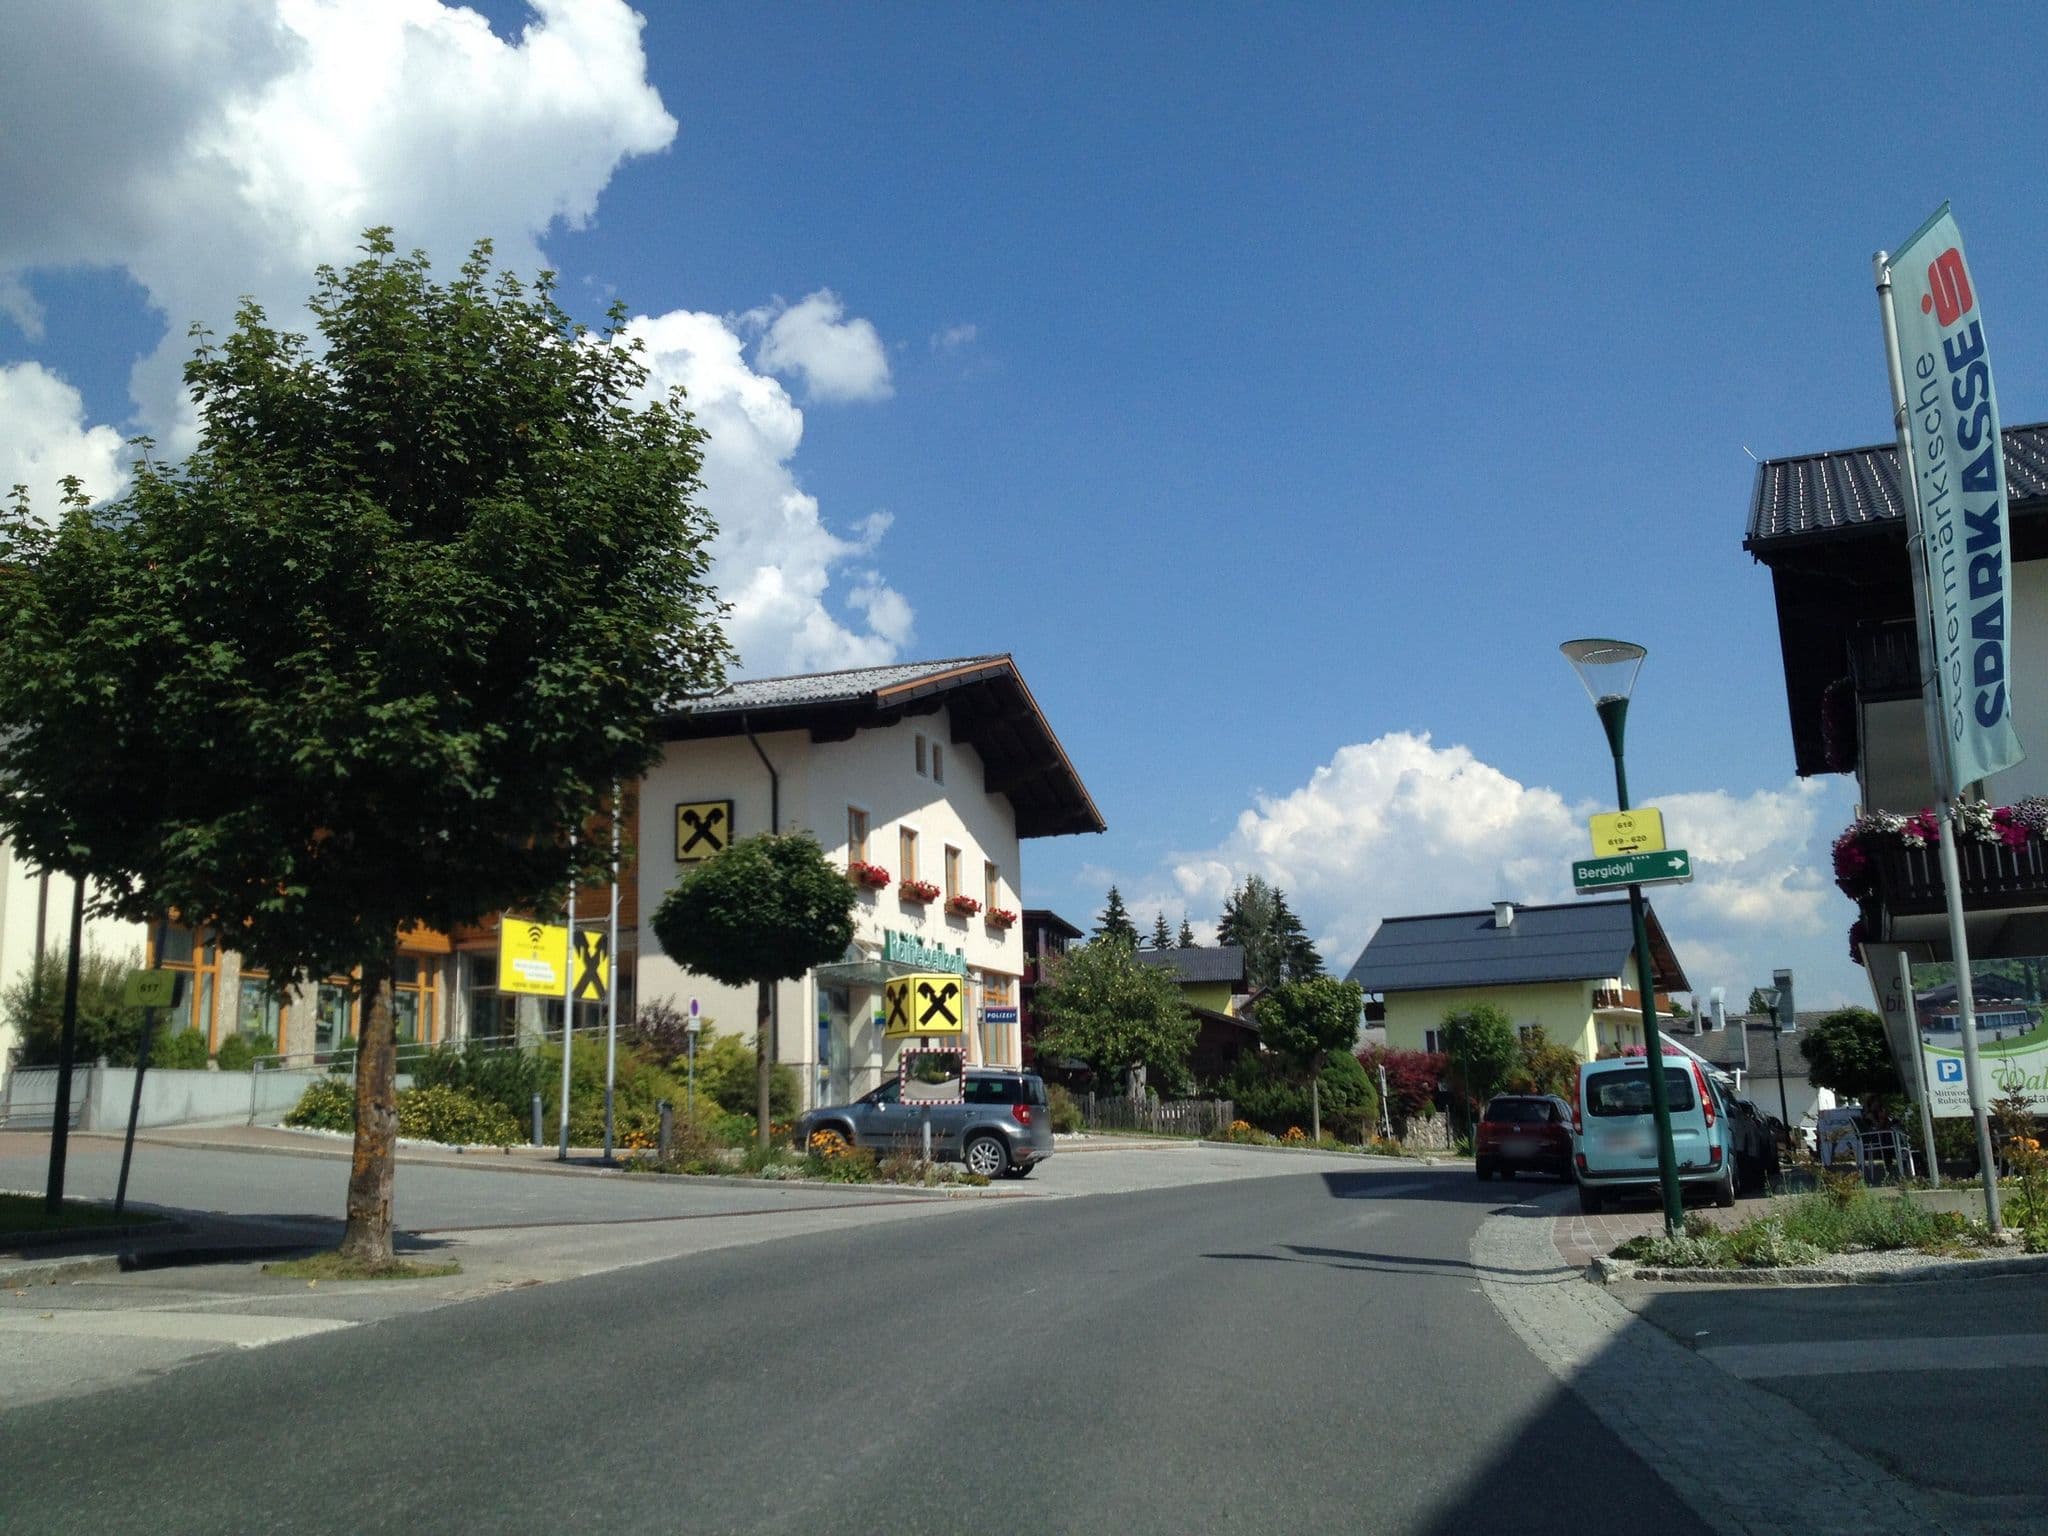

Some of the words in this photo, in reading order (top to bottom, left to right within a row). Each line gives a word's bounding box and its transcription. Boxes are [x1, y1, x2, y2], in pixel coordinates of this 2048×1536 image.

[1943, 319, 2006, 728] SPARKASSE
[1578, 862, 1634, 879] Bergidyll
[140, 984, 159, 992] 617
[1934, 1089, 1968, 1097] Mittwoc
